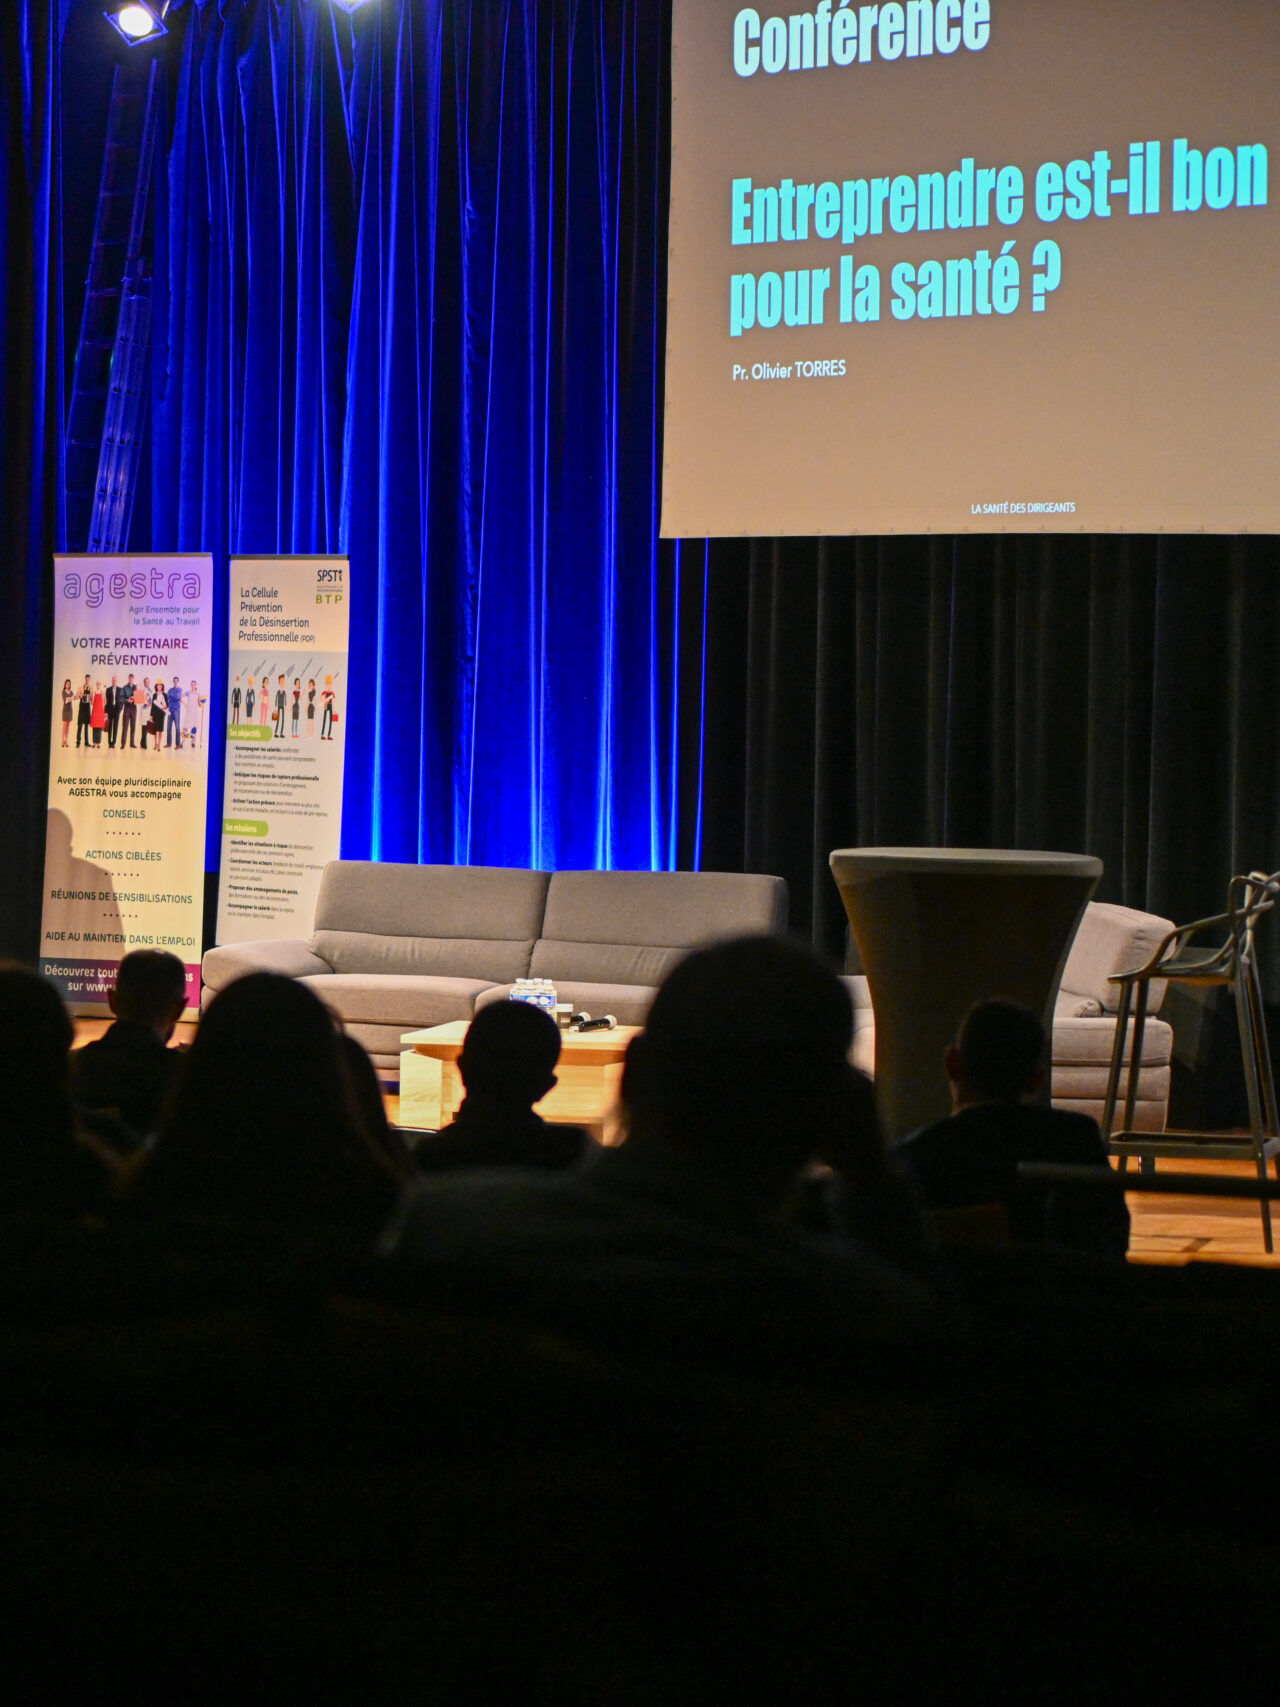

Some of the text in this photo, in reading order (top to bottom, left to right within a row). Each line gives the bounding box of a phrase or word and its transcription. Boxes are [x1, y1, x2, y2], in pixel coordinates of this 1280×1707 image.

[733, 0, 991, 77] Conférence
[731, 138, 1268, 245] Entreprendre est-il bon
[730, 239, 1062, 336] pour la santé ?
[732, 359, 846, 380] Pr. Olivier TORRES
[971, 501, 1075, 514] LA SANTÉ DES DIRIGEANTS
[64, 567, 201, 608] agestra
[240, 587, 278, 598] La Cellule
[129, 605, 200, 615] Agir Ensemble pour
[240, 601, 283, 613] Prévention
[133, 617, 141, 625] la
[142, 616, 164, 625] Santé
[176, 617, 200, 625] Travail
[239, 616, 309, 628] de la Désinsertion
[238, 630, 299, 642] Professionnelle
[71, 637, 189, 649] VOTRE PARTENAIRE
[91, 652, 168, 666] PRÉVENTION
[57, 776, 77, 785] Avec
[95, 776, 122, 787] équipe
[124, 777, 192, 788] pluridisciplinaire
[69, 788, 182, 801] AGESTRA vous accompagne
[102, 809, 146, 819] CONSEILS
[85, 849, 162, 861] ACTIONS CIBLÉES
[51, 888, 193, 904] RÉUNIONS DE SENSIBILISATIONS
[45, 931, 196, 946] AIDE AU MAINTIEN DANS L'EMPLOI
[45, 964, 119, 979] Découvrez tout
[67, 981, 84, 991] sur
